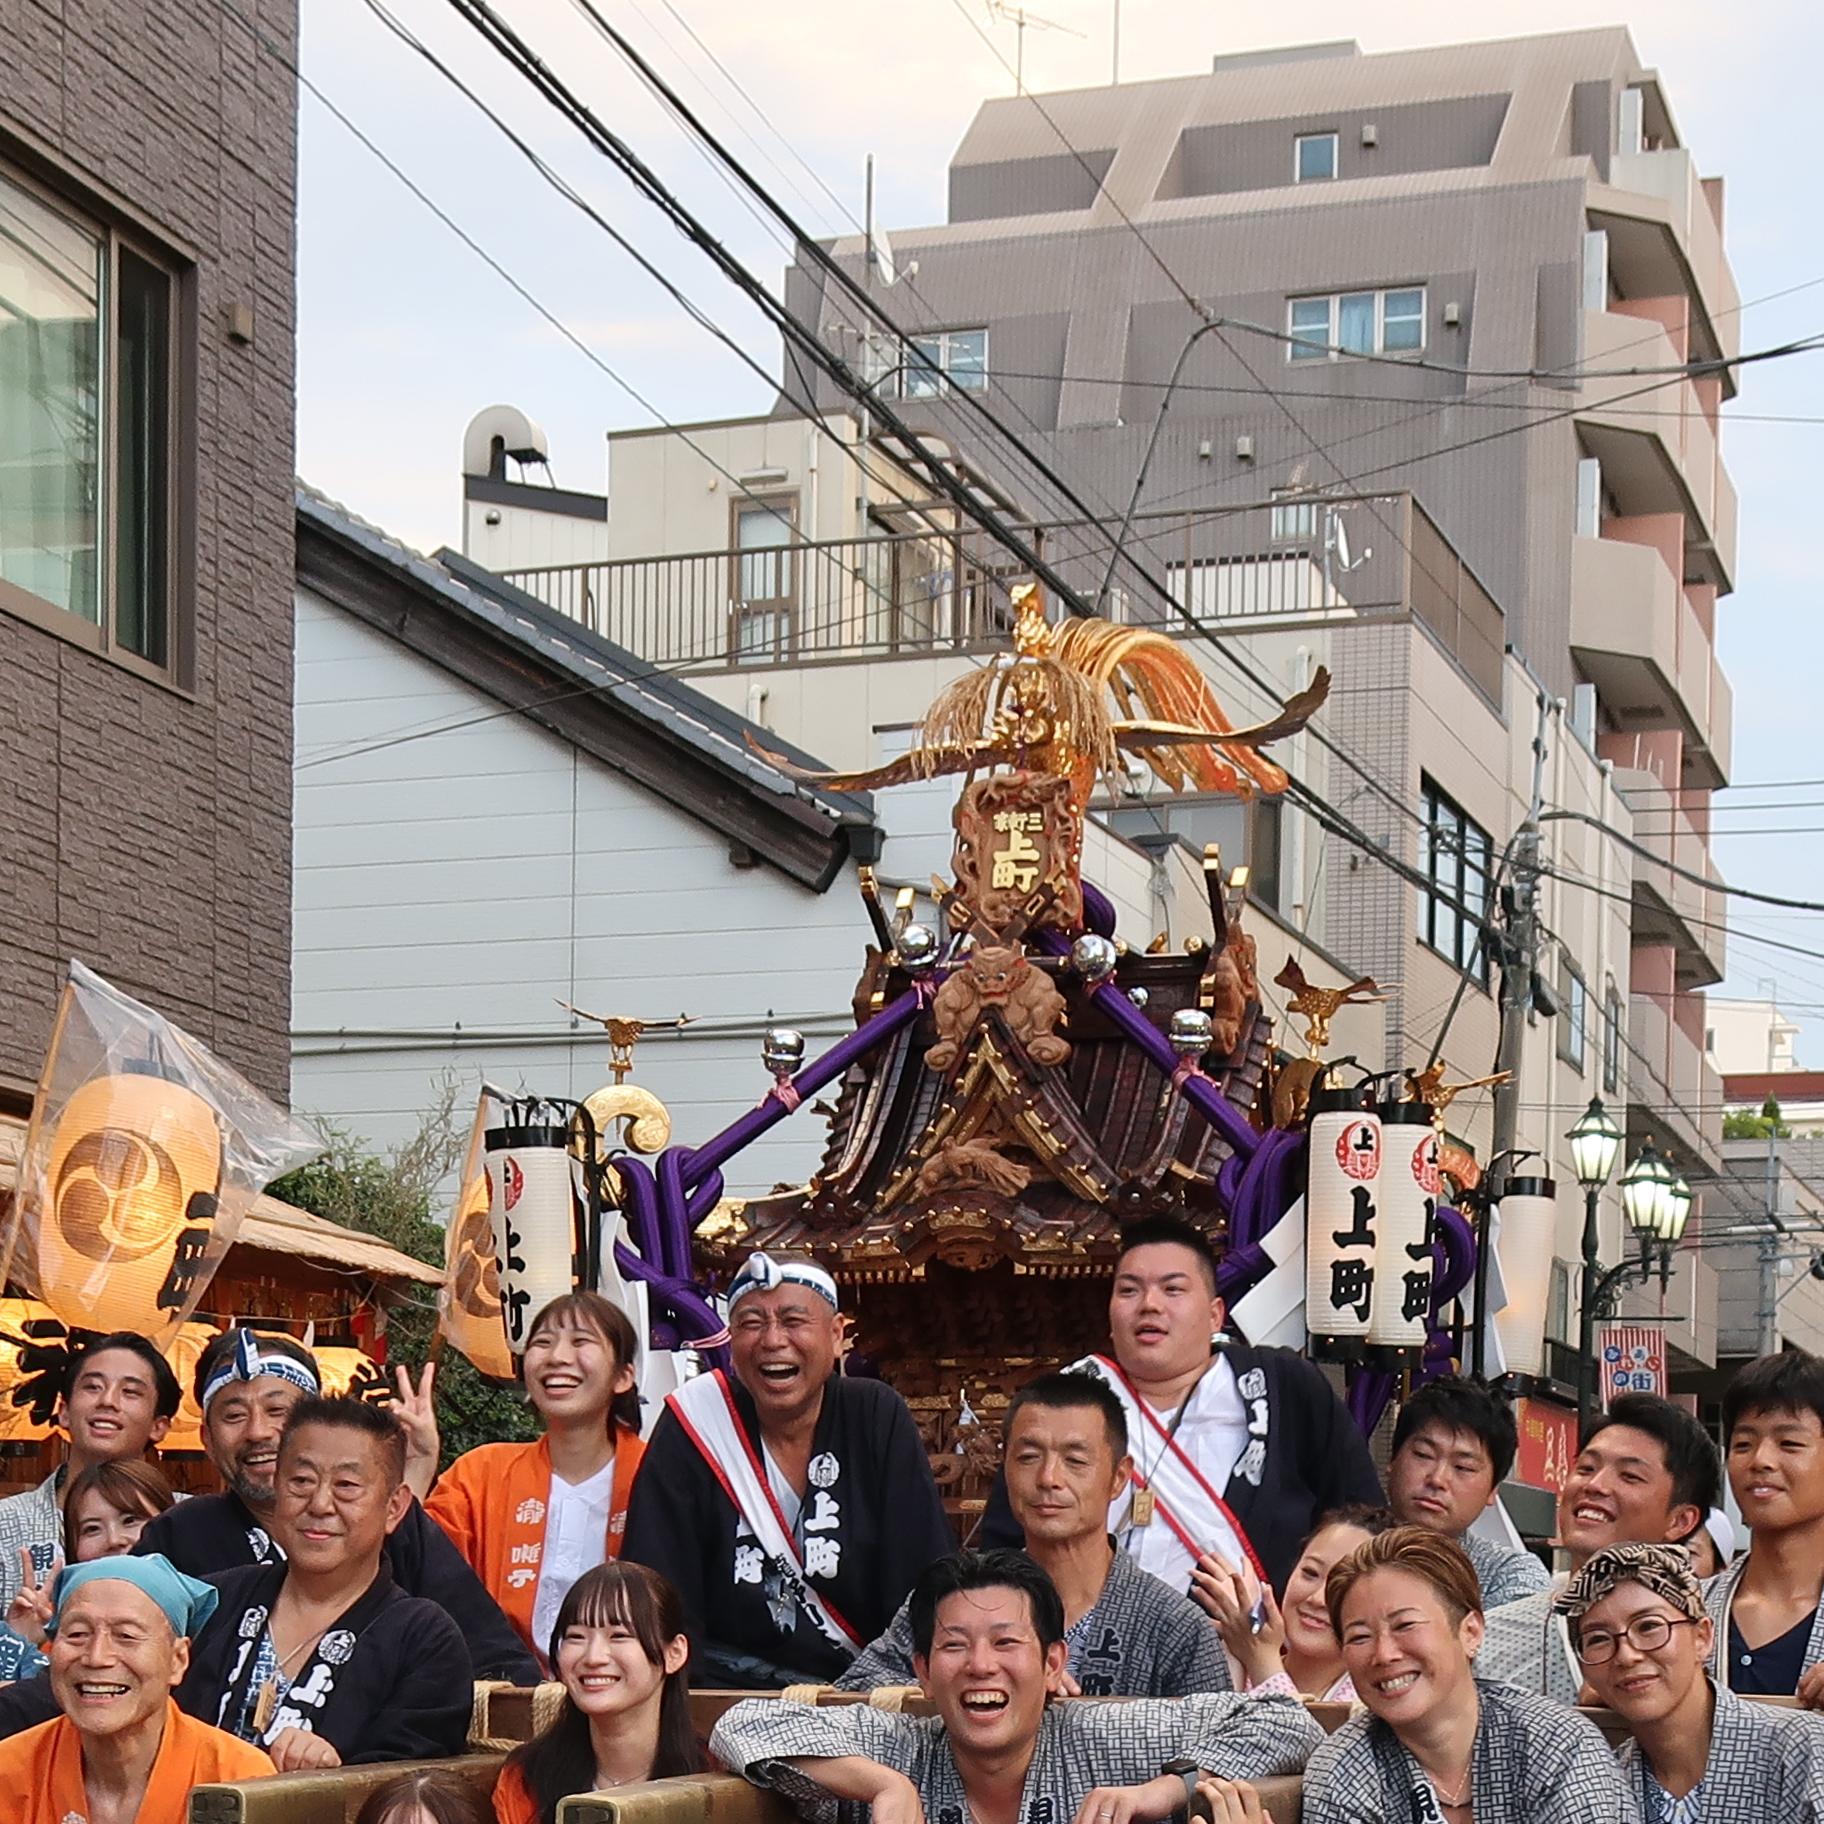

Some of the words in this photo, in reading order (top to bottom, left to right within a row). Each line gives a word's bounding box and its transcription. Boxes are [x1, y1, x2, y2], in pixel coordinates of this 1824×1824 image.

[992, 828, 1040, 893] 上町
[1330, 1185, 1376, 1323] 上町
[804, 1490, 842, 1580] 上町
